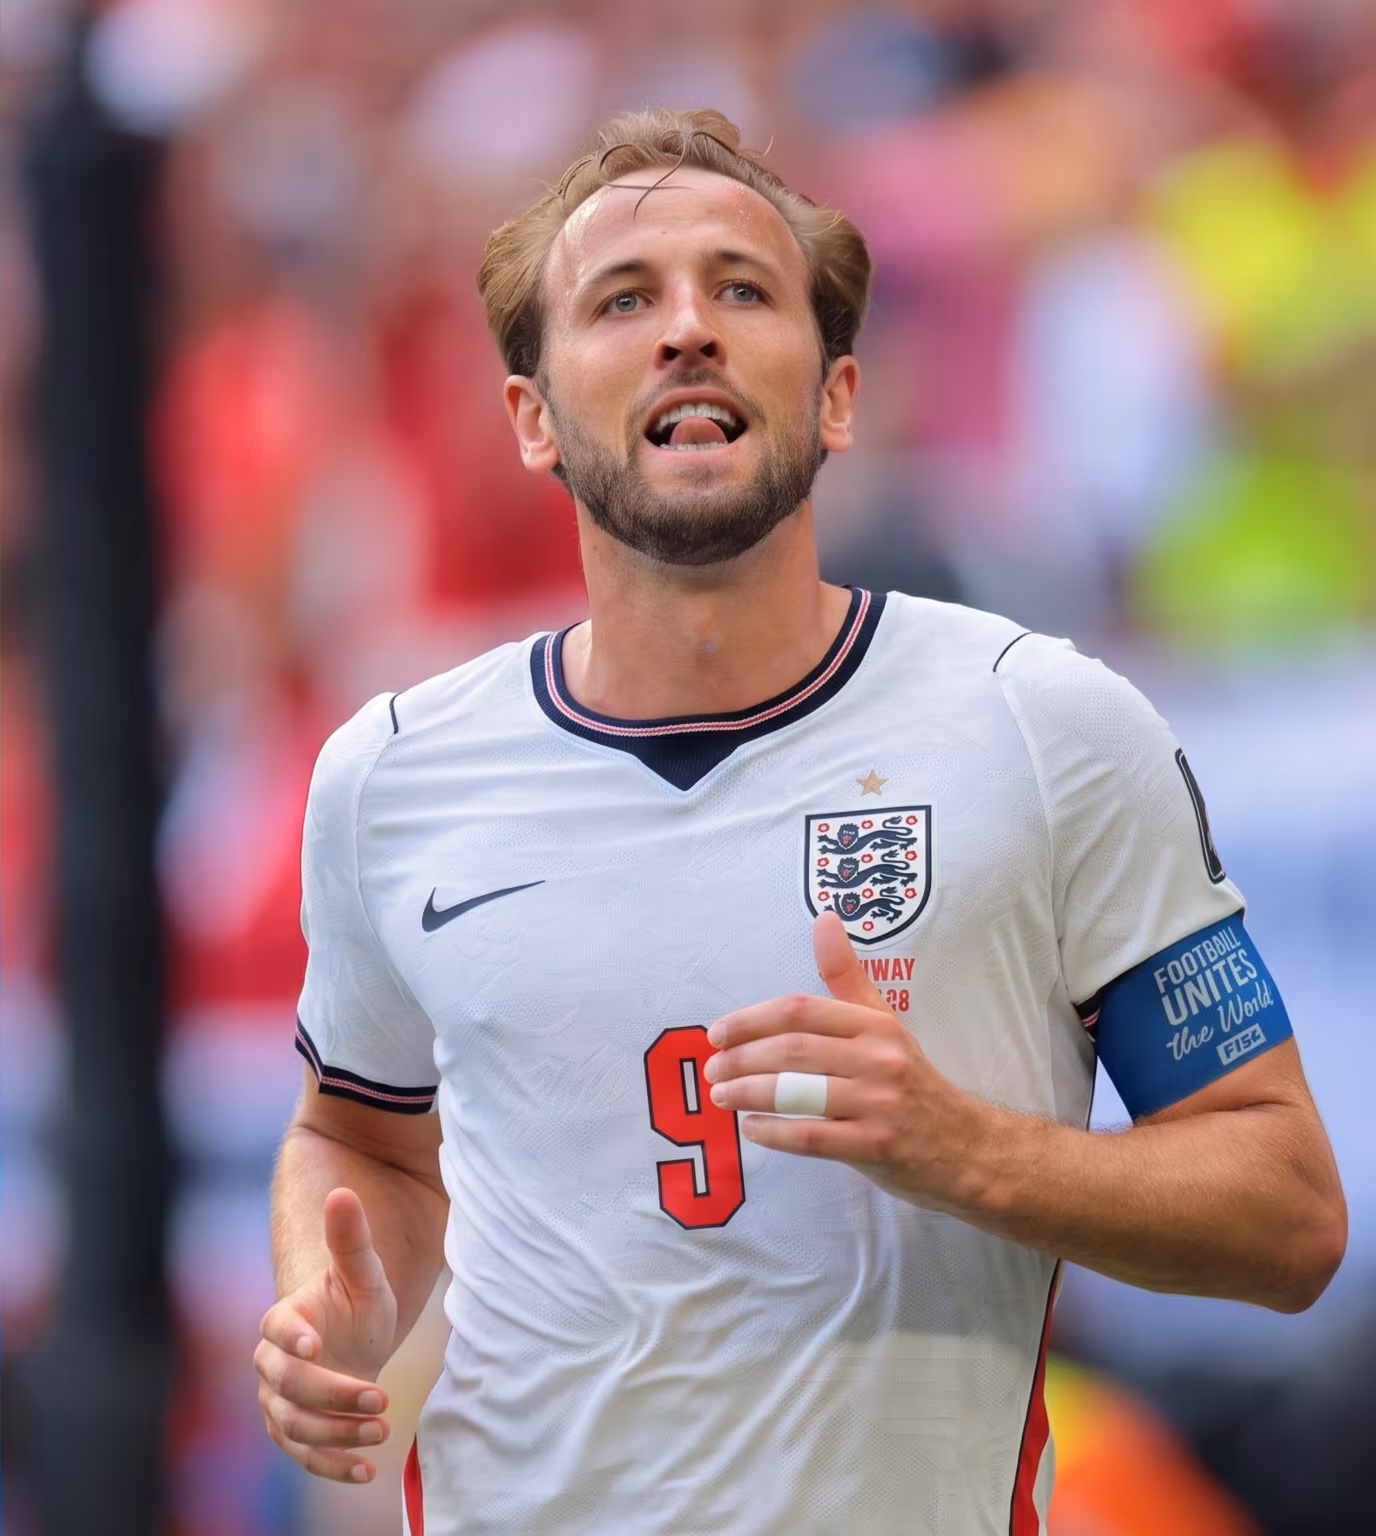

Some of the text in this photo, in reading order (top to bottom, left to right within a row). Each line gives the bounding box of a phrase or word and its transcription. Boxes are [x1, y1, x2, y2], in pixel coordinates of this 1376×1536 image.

[1161, 948, 1258, 1026] UNITES
[1166, 979, 1274, 1061] the World
[643, 1024, 747, 1231] 9
